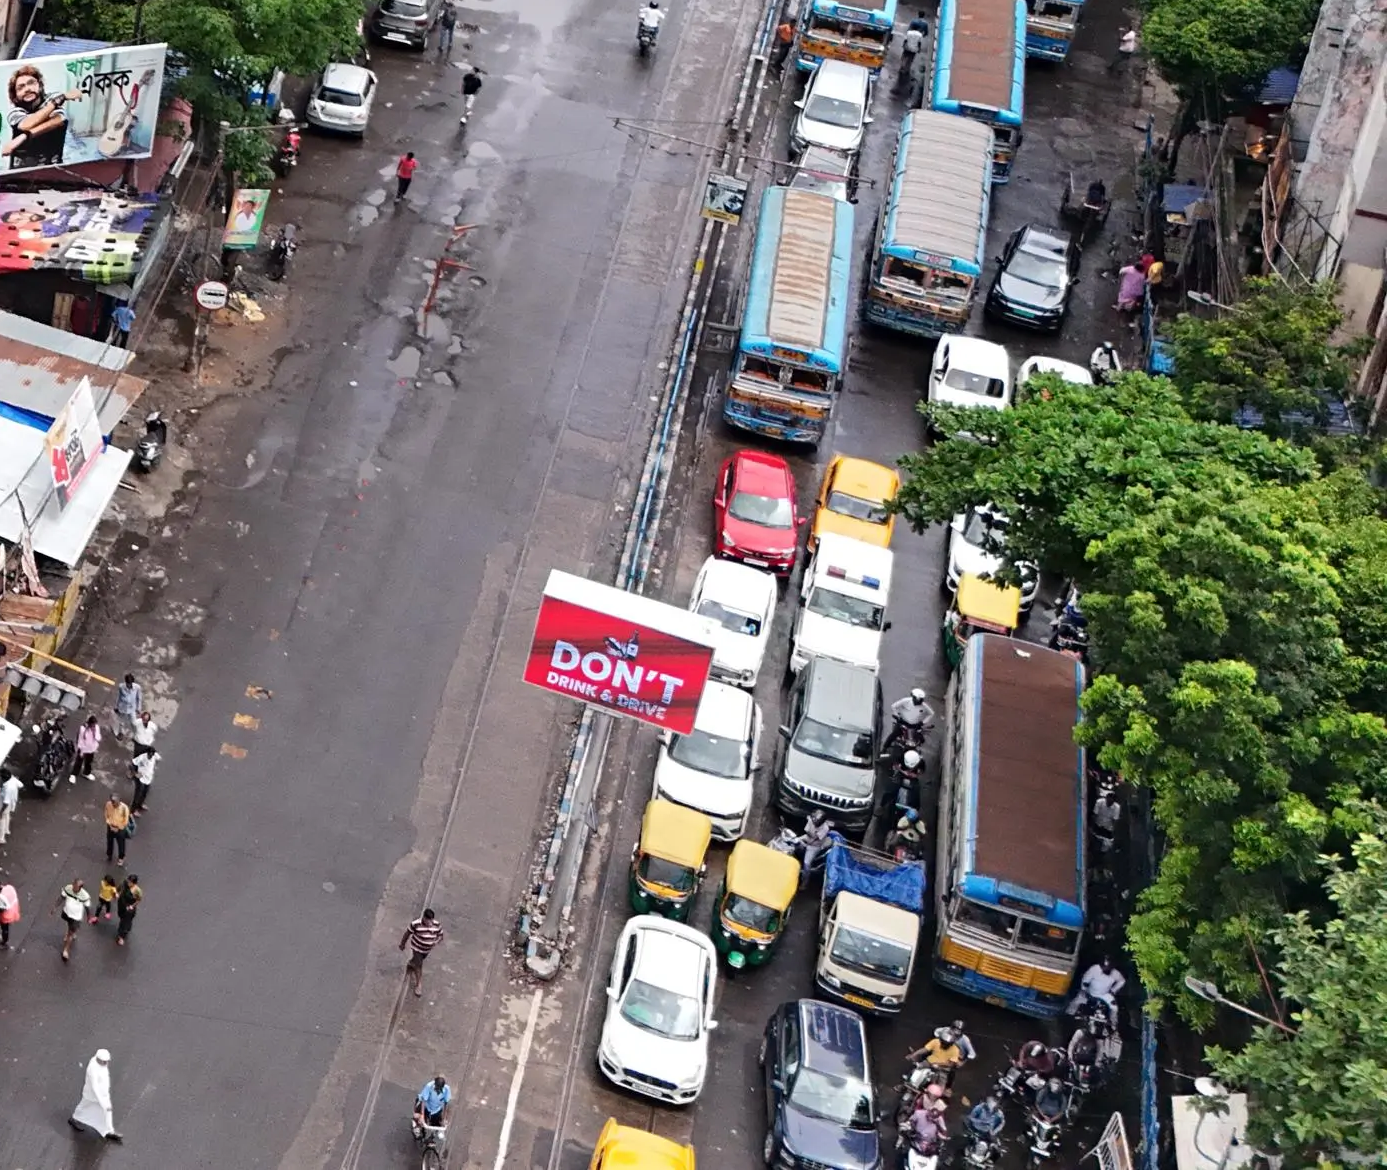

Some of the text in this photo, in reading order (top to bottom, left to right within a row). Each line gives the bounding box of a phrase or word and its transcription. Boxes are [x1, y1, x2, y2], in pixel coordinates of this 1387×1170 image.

[81, 69, 133, 98] একক
[545, 671, 668, 721] DRINK & DRIVE
[549, 639, 684, 705] DON'T
